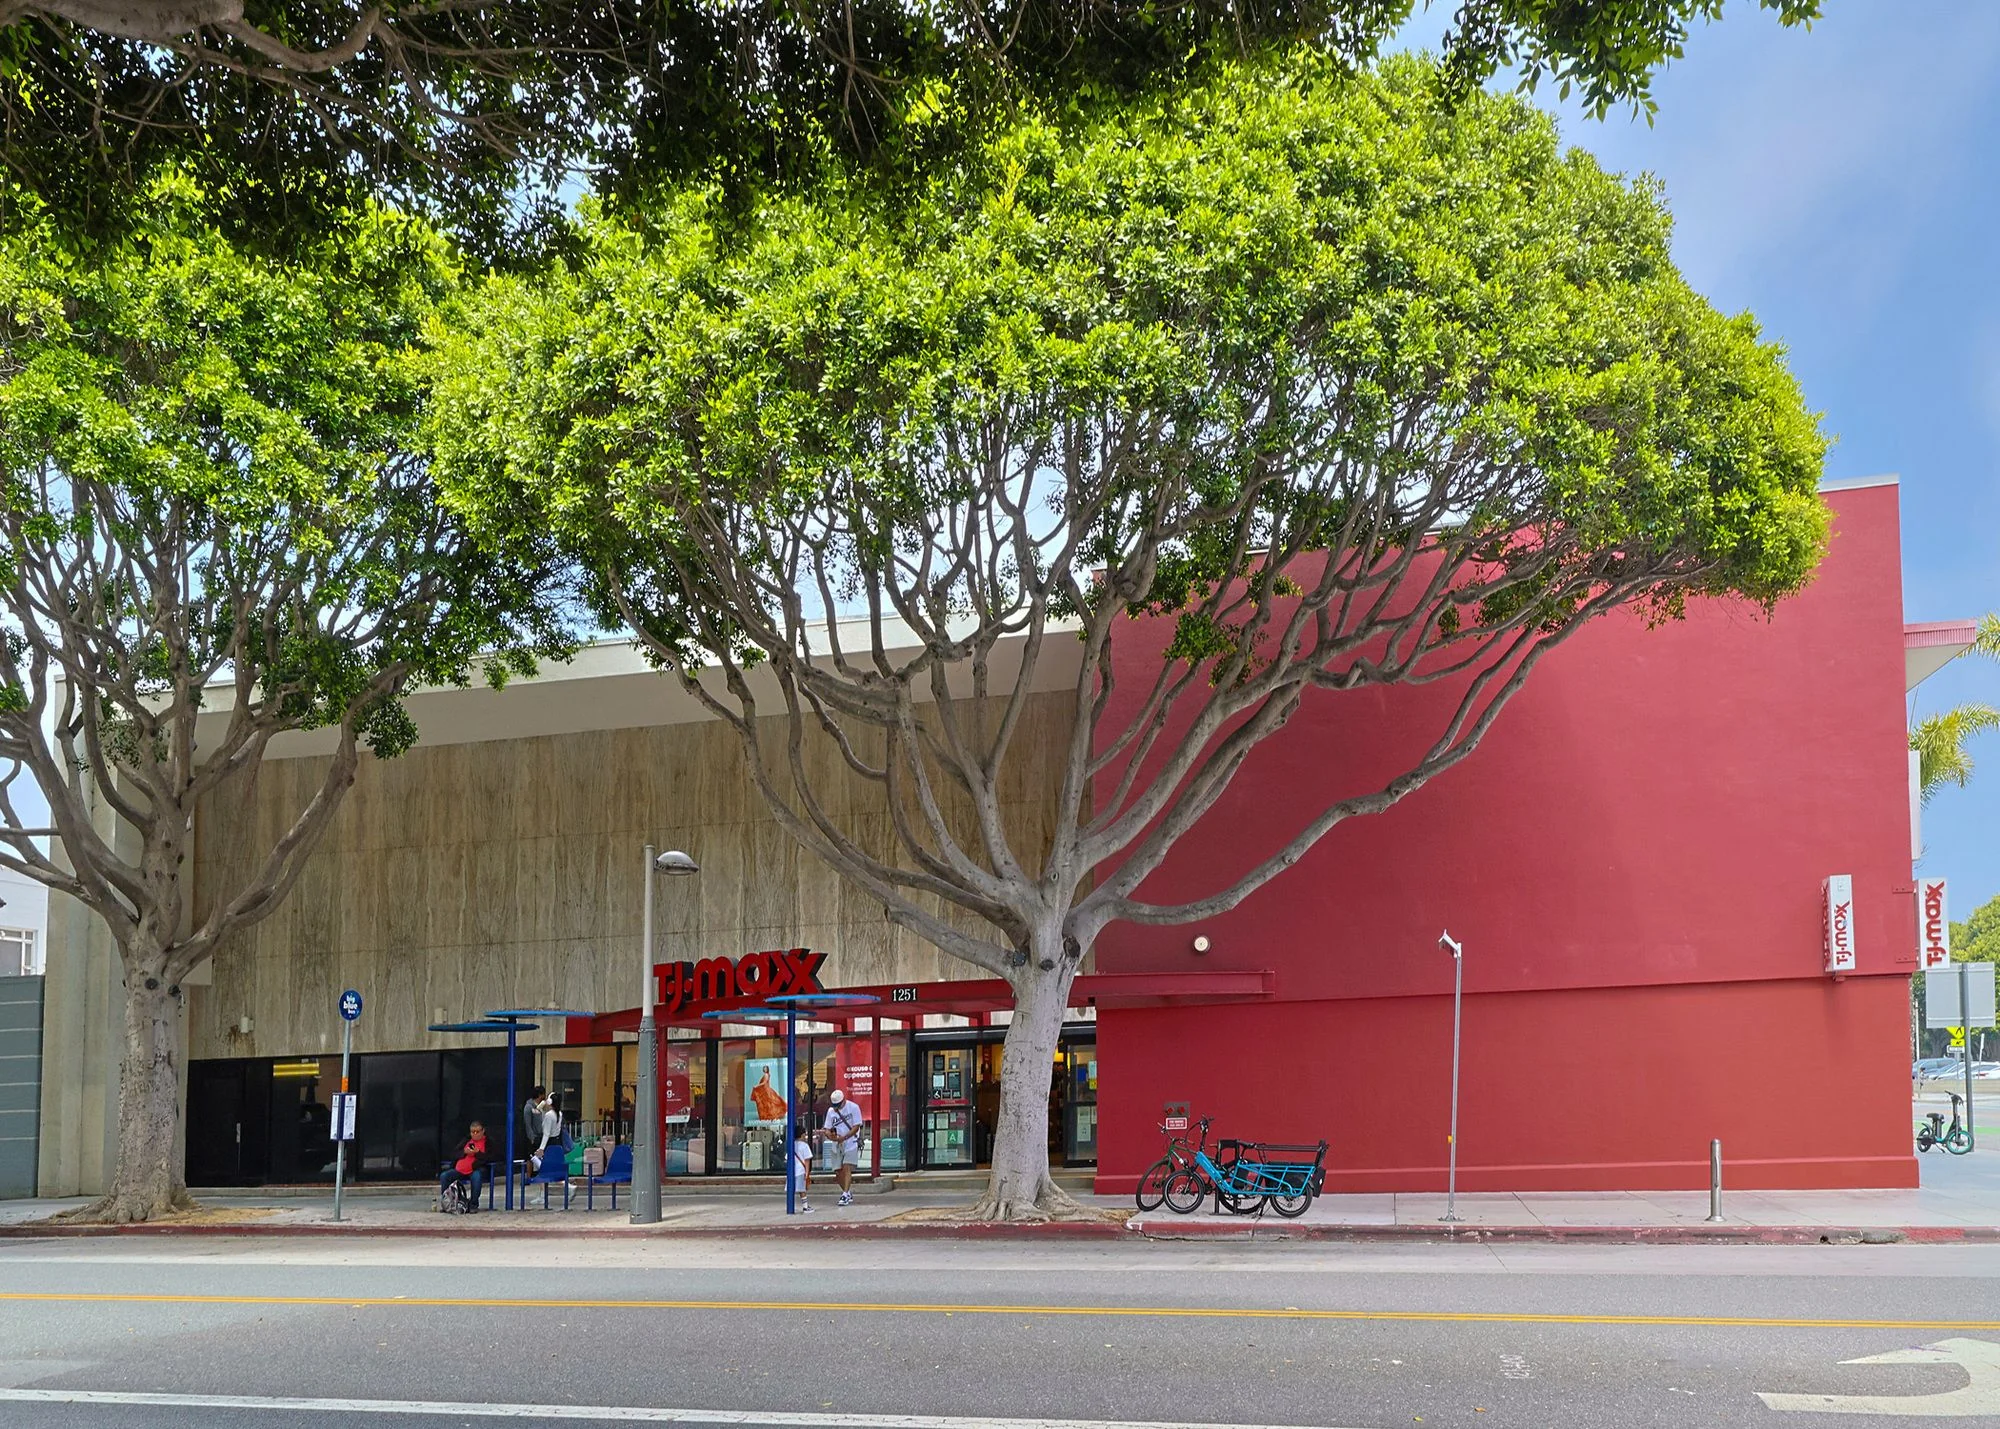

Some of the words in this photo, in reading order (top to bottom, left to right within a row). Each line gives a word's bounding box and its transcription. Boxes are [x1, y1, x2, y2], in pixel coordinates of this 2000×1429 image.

[893, 988, 916, 1001] 1251
[346, 995, 356, 1003] big
[343, 1001, 358, 1009] blue
[950, 1133, 956, 1141] A
